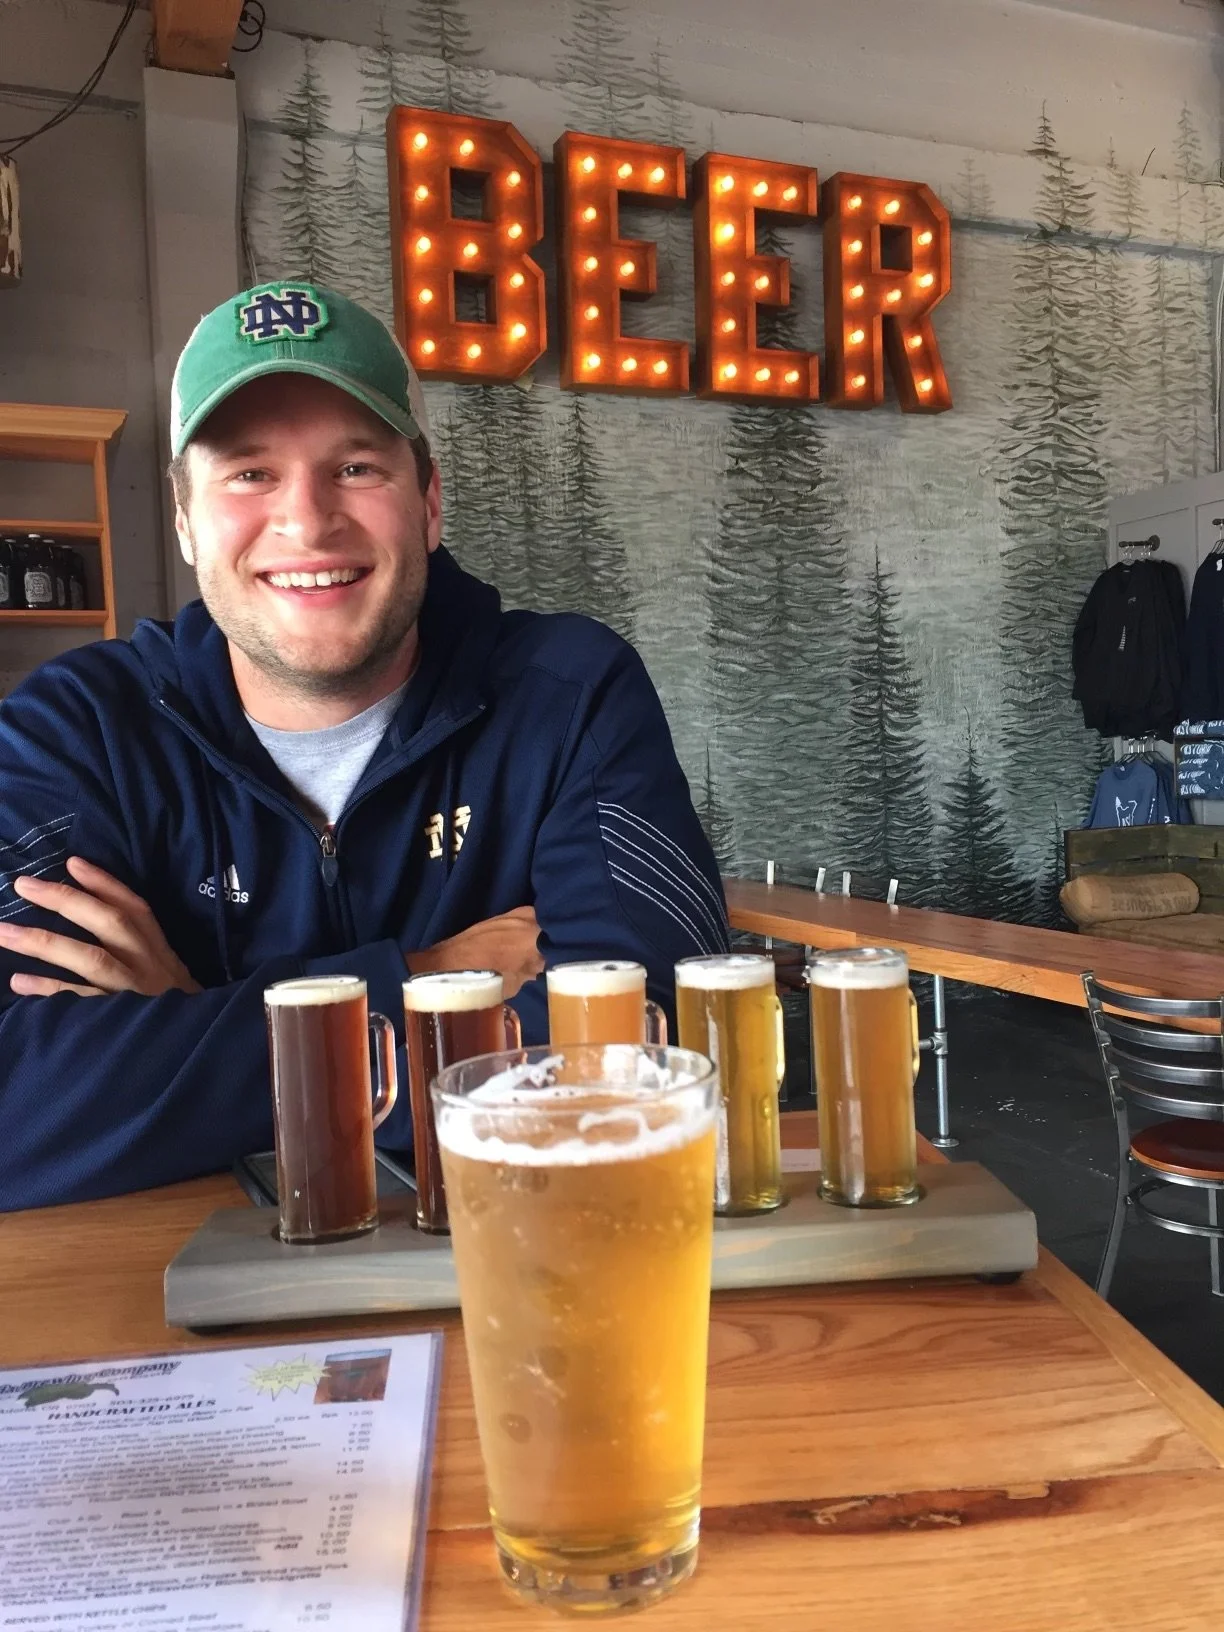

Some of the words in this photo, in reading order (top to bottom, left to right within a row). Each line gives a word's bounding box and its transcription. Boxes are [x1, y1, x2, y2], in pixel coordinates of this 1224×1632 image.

[386, 104, 953, 413] BEER
[48, 1404, 171, 1420] HANDCRAFTED
[176, 1399, 216, 1410] ALES
